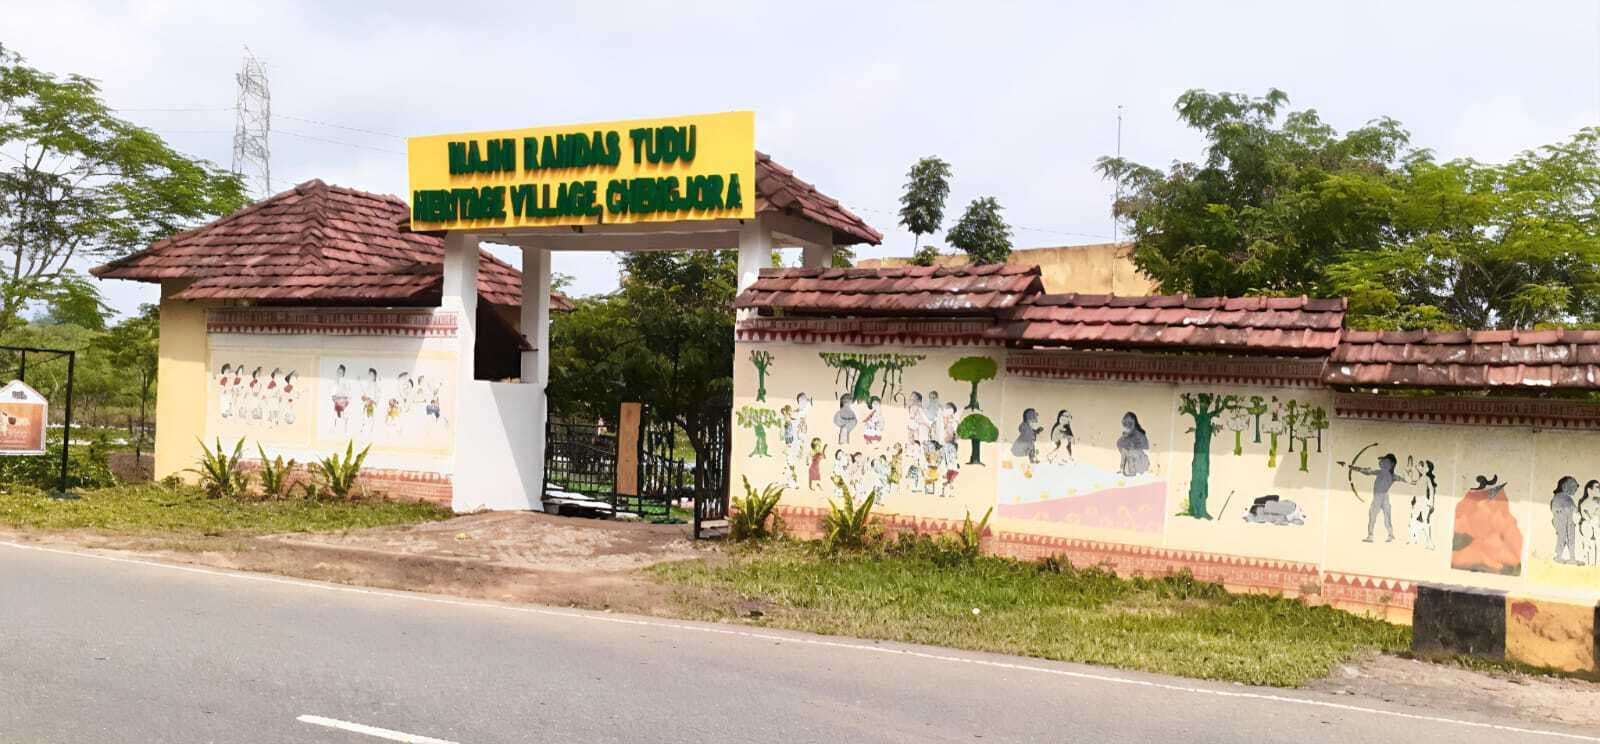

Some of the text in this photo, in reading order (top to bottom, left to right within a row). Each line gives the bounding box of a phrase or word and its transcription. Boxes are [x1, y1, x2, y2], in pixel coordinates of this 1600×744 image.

[523, 130, 621, 170] RAMDAS
[629, 124, 697, 164] TUDU
[413, 185, 507, 223] HERITAGE
